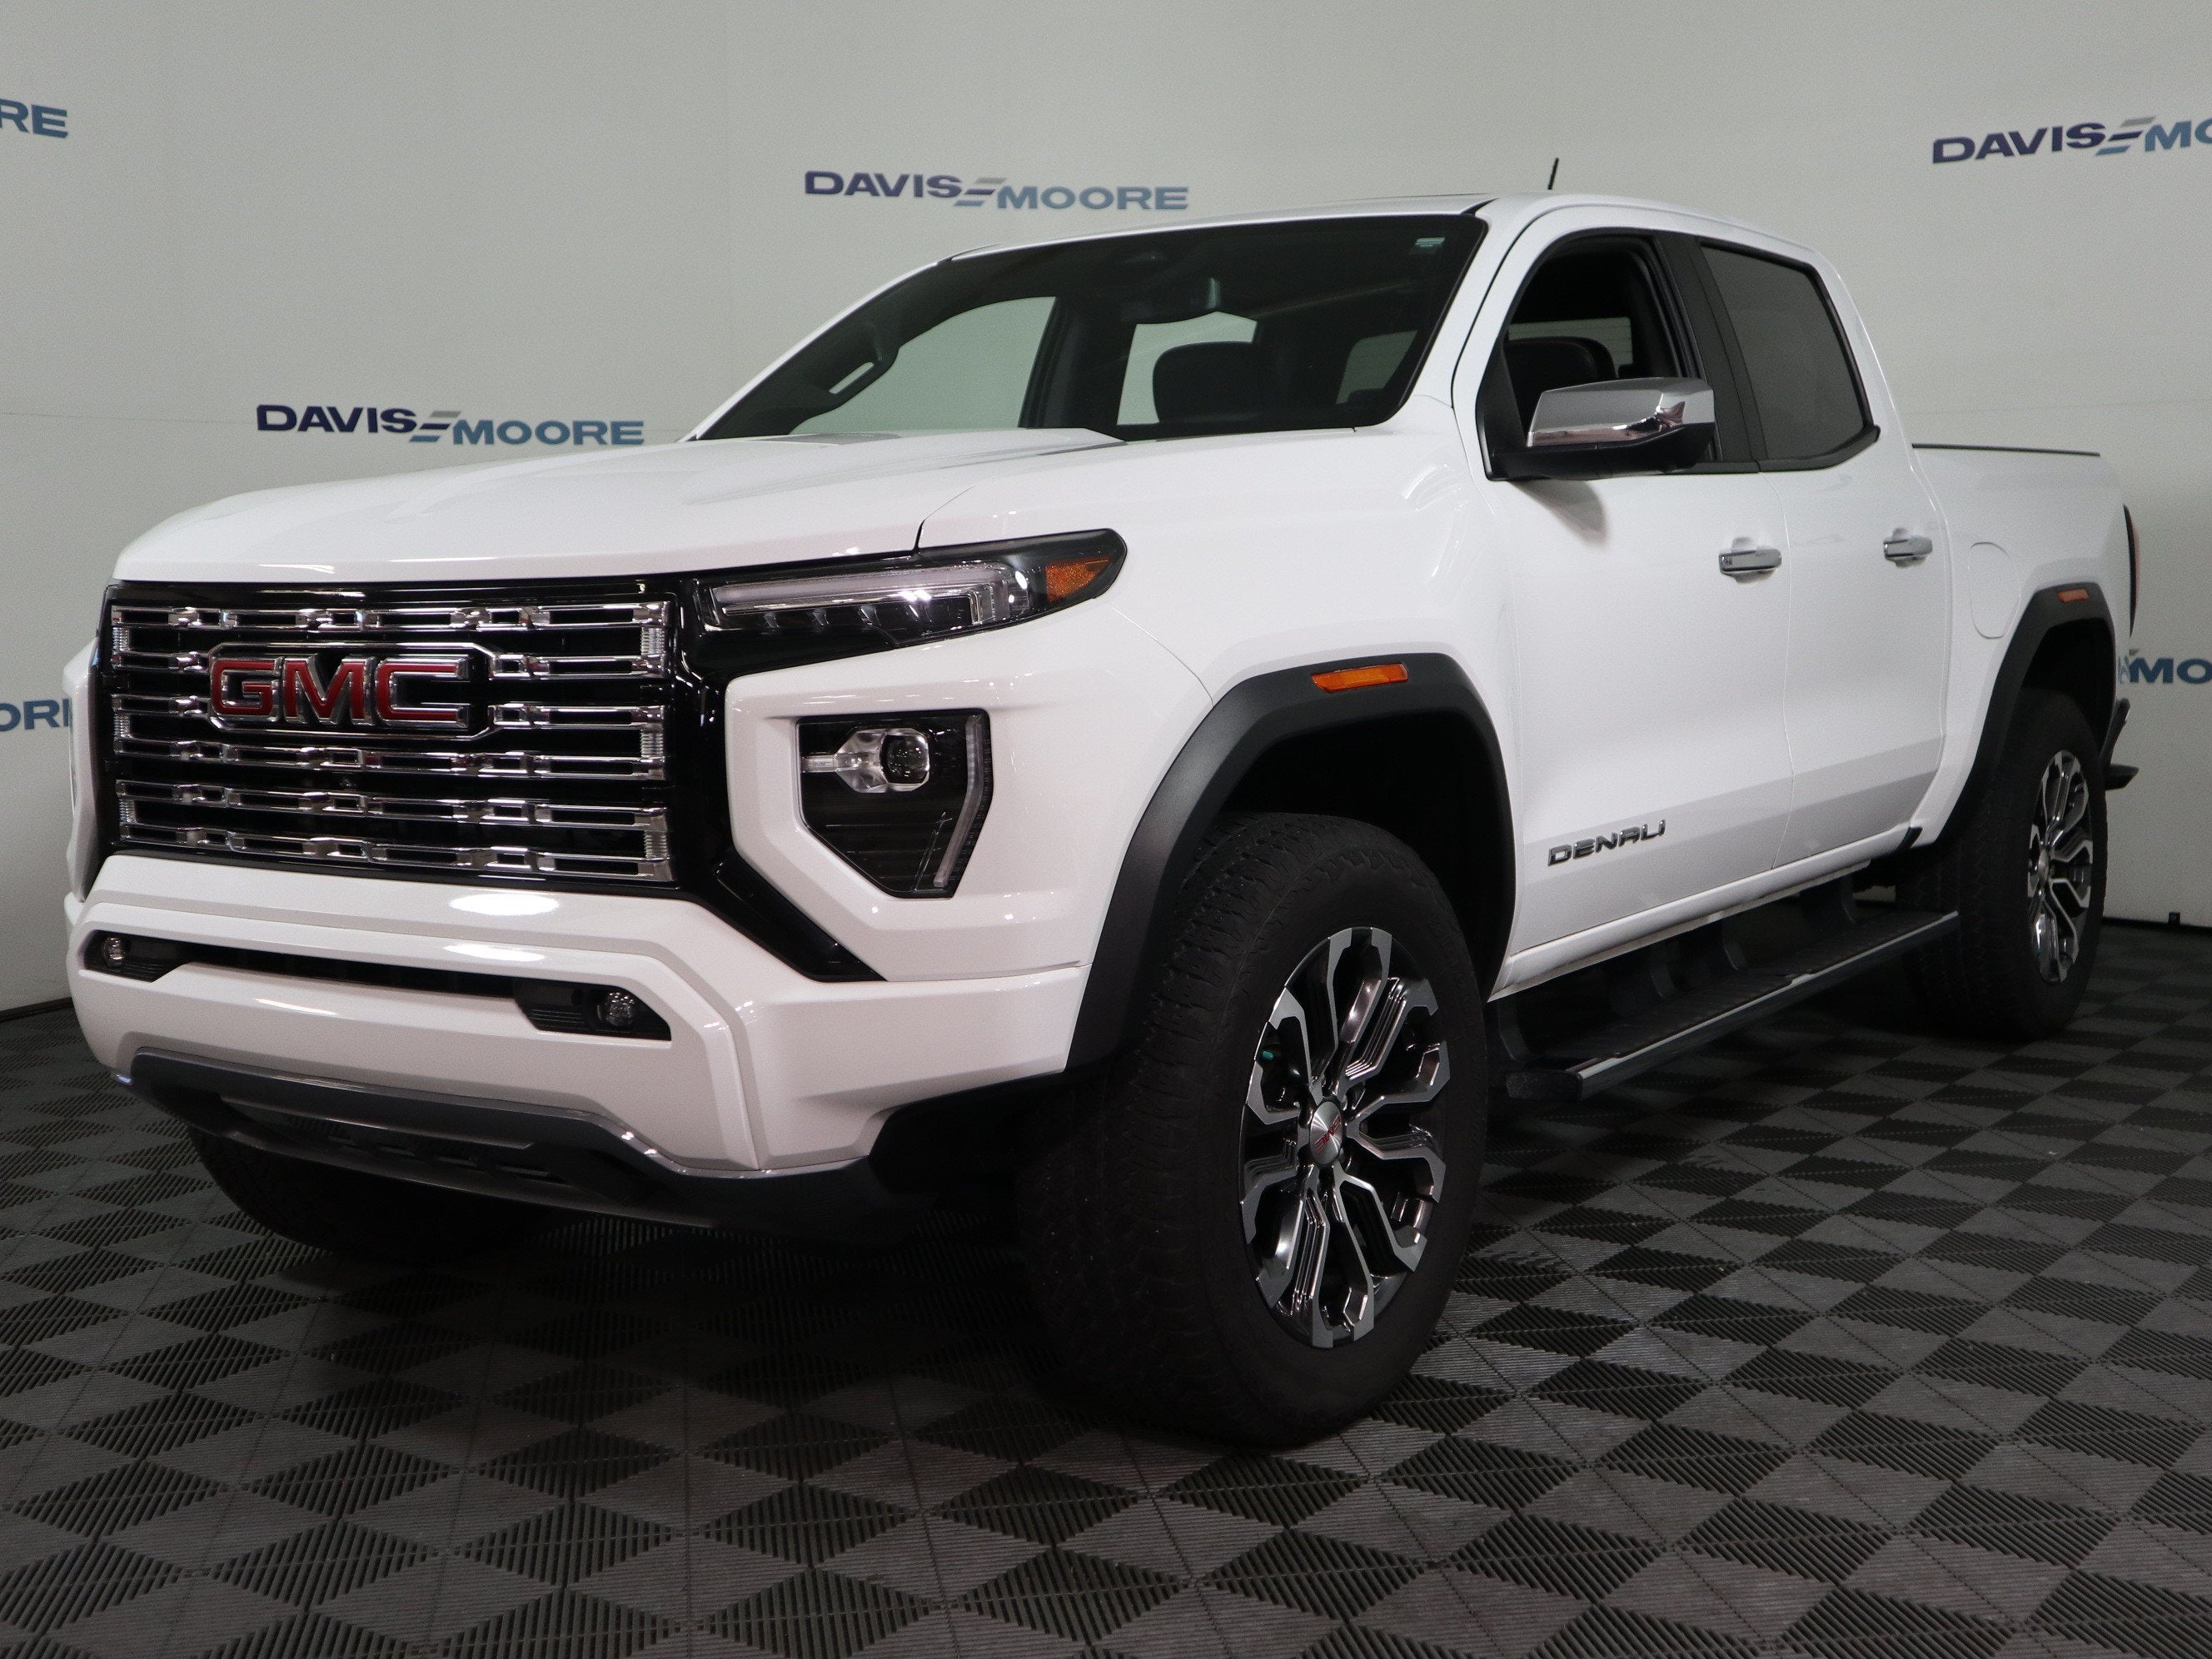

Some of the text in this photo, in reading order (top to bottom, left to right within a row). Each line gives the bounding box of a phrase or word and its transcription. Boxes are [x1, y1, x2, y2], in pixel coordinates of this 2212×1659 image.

[1933, 122, 2106, 163] DAVIS
[805, 171, 1188, 210] DAVIS MOORE
[257, 404, 645, 446] DAVIS MOORE
[210, 655, 471, 728] GMC
[1547, 819, 1666, 866] DENALI
